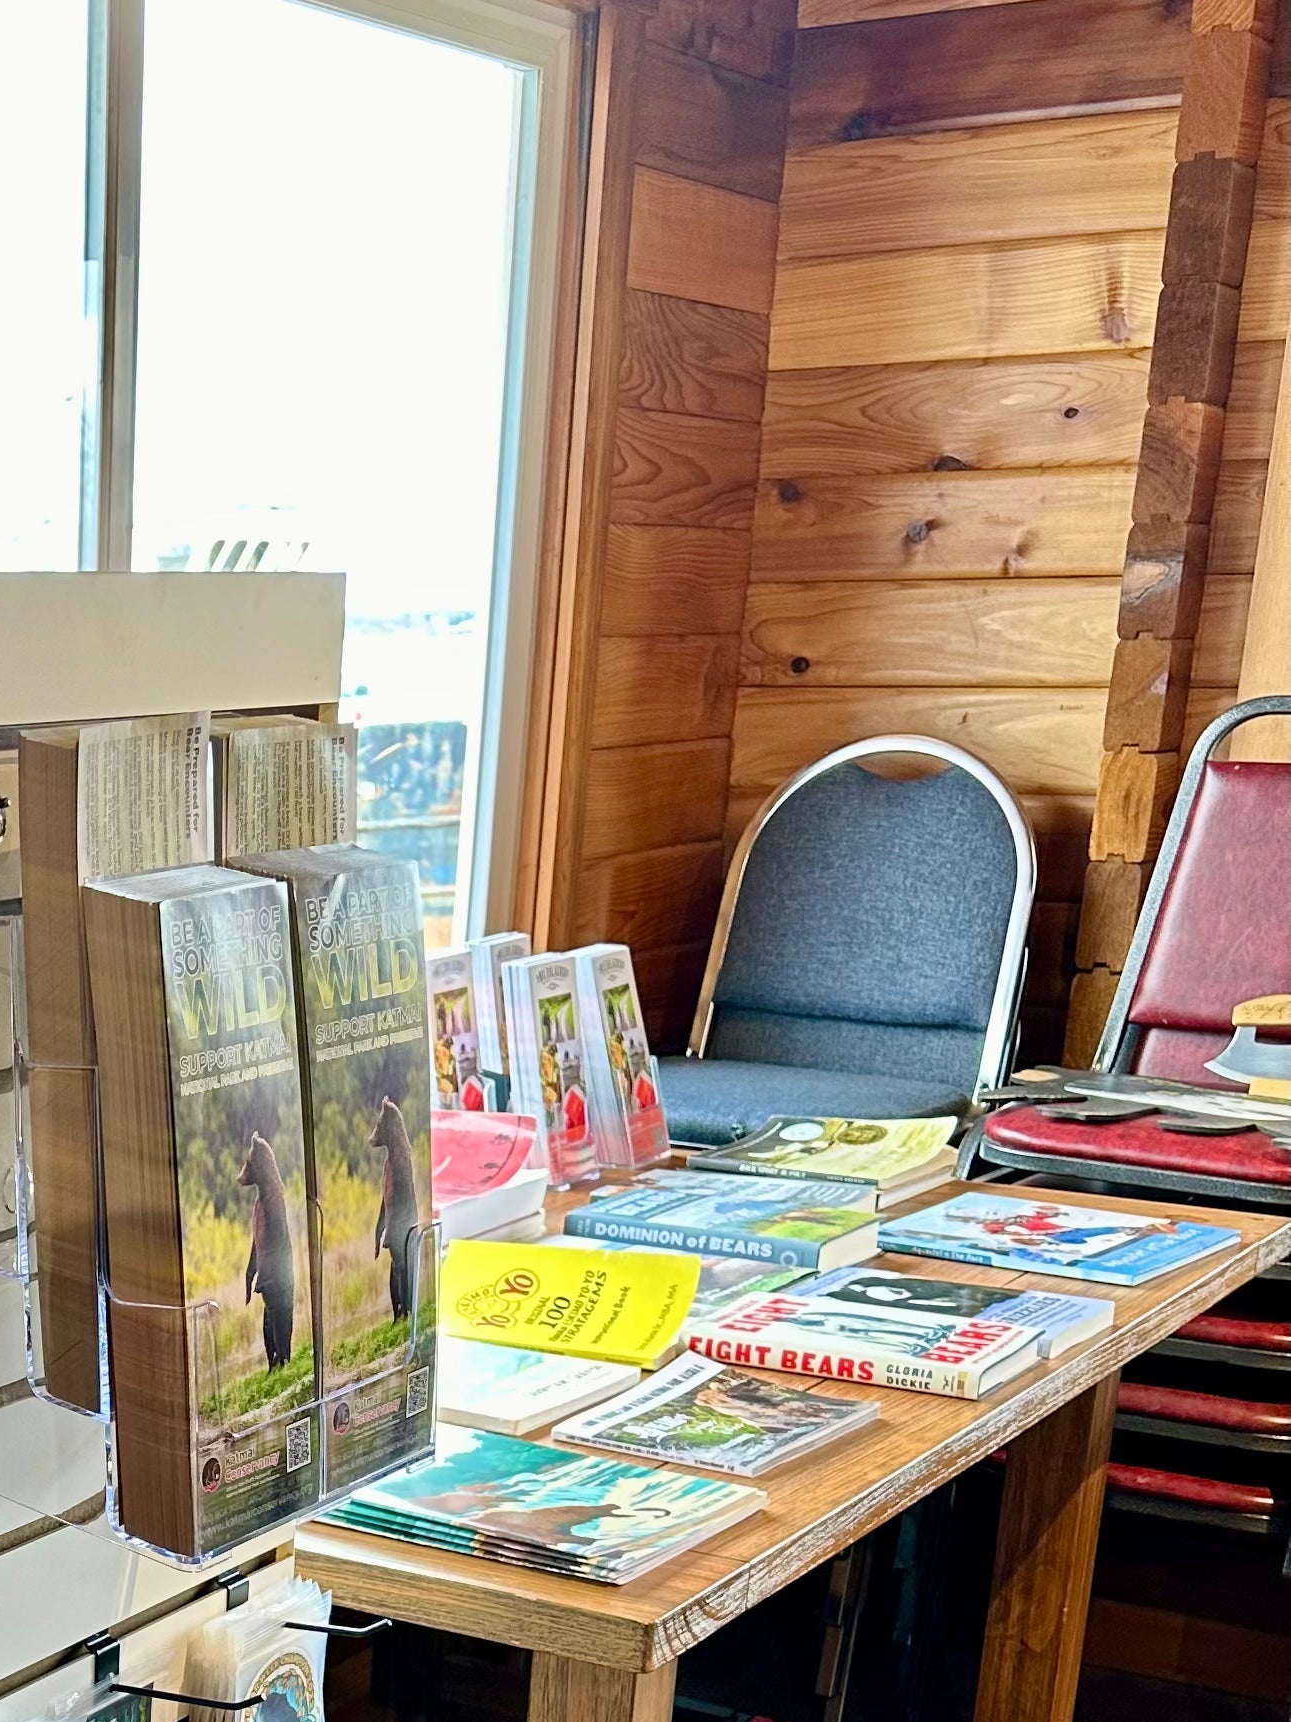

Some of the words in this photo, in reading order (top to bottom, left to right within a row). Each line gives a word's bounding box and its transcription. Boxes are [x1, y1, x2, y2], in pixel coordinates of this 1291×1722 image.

[171, 919, 193, 946] BE
[197, 917, 211, 942] A
[213, 907, 257, 939] PART
[259, 905, 281, 932] OF
[307, 897, 326, 924] BE
[330, 895, 344, 918] A
[346, 886, 386, 916] PART
[308, 908, 413, 952] SOMETHING
[172, 934, 282, 978] SOMETHING
[310, 938, 419, 1010] WILD
[176, 964, 287, 1041] WILD
[315, 1013, 375, 1045] SUPPORT
[377, 1002, 422, 1031] KATMAI
[180, 1043, 243, 1078] SUPPORT
[244, 1032, 291, 1062] KATMAI
[594, 1222, 685, 1249] DOMINION
[687, 1235, 706, 1249] of
[709, 1236, 773, 1258] BEARS
[580, 1270, 595, 1299] YO-YO
[615, 1286, 631, 1310] Book
[539, 1296, 571, 1329] 100
[560, 1271, 607, 1344] STRATAGEMS
[718, 1298, 809, 1332] EIGHT
[689, 1336, 771, 1365] EIGHT
[780, 1349, 875, 1382] BEARS
[923, 1322, 1012, 1364] BEARS
[886, 1364, 934, 1380] GLORIA
[886, 1376, 931, 1390] DICKIE
